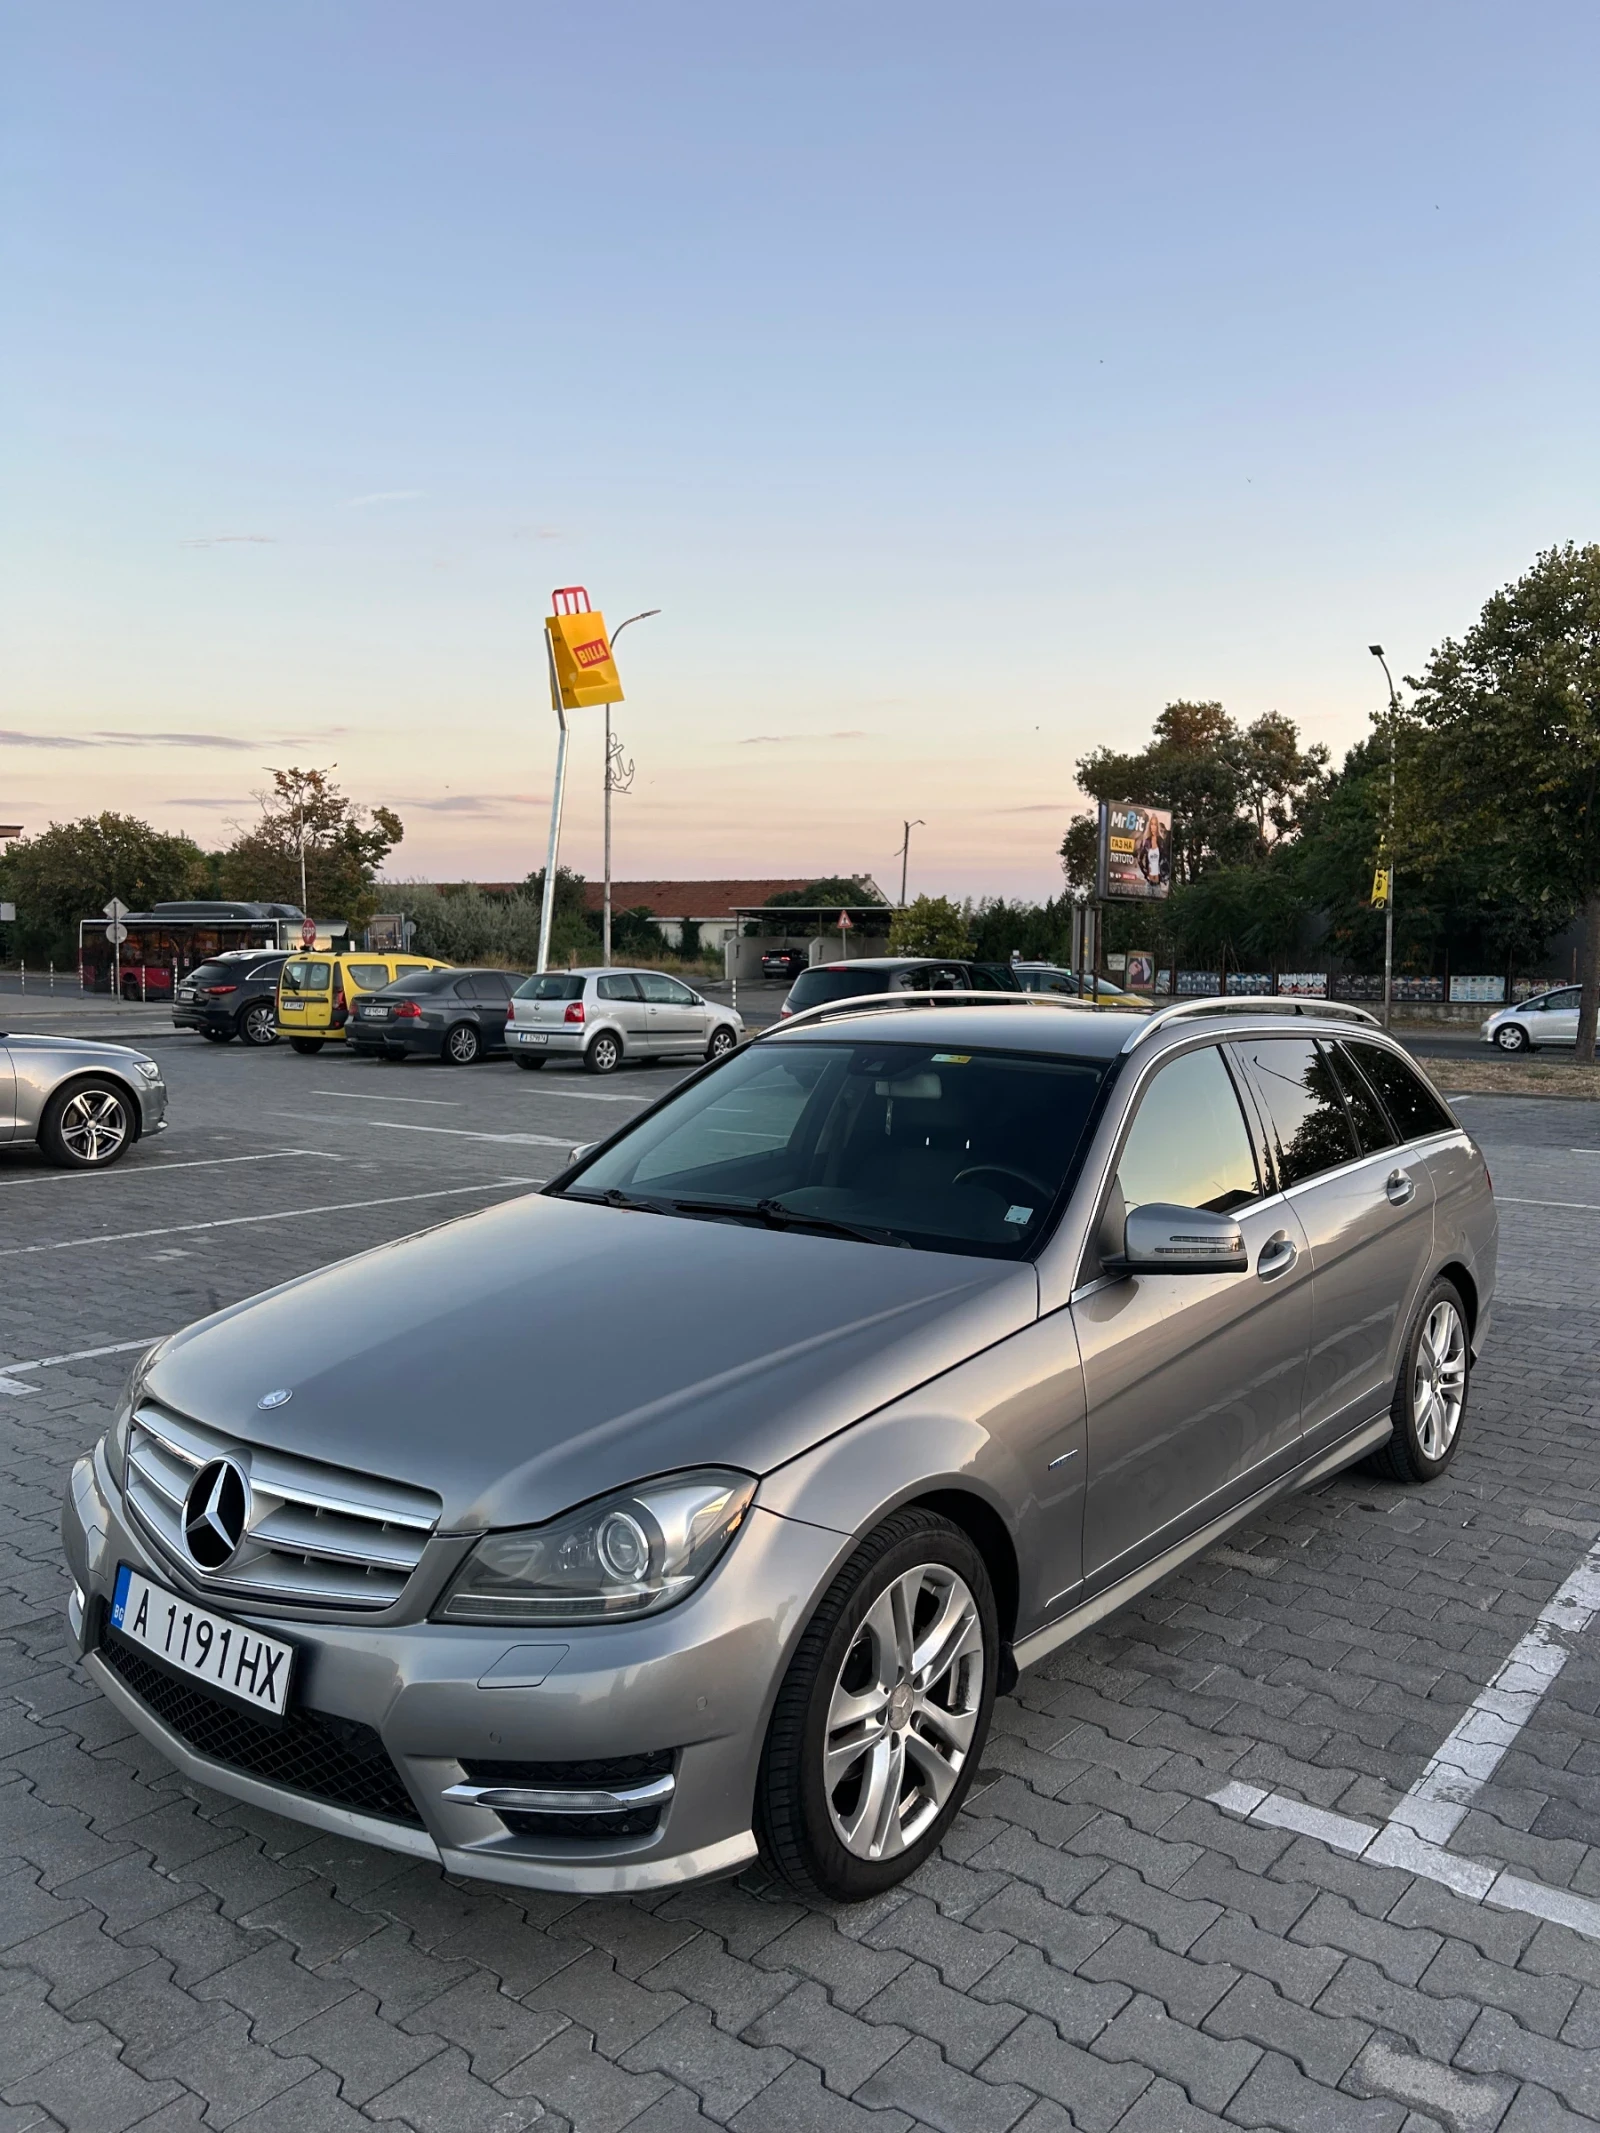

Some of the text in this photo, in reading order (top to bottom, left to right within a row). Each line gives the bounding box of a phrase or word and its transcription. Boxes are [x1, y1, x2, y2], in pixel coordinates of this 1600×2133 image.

[577, 643, 606, 664] BILLA
[1111, 810, 1145, 832] MrBit
[1111, 838, 1133, 850] ГАЗ НА
[1110, 852, 1134, 865] ЛЯТОТО
[303, 927, 315, 937] STOP
[113, 1587, 285, 1704] BG A 1191HX
